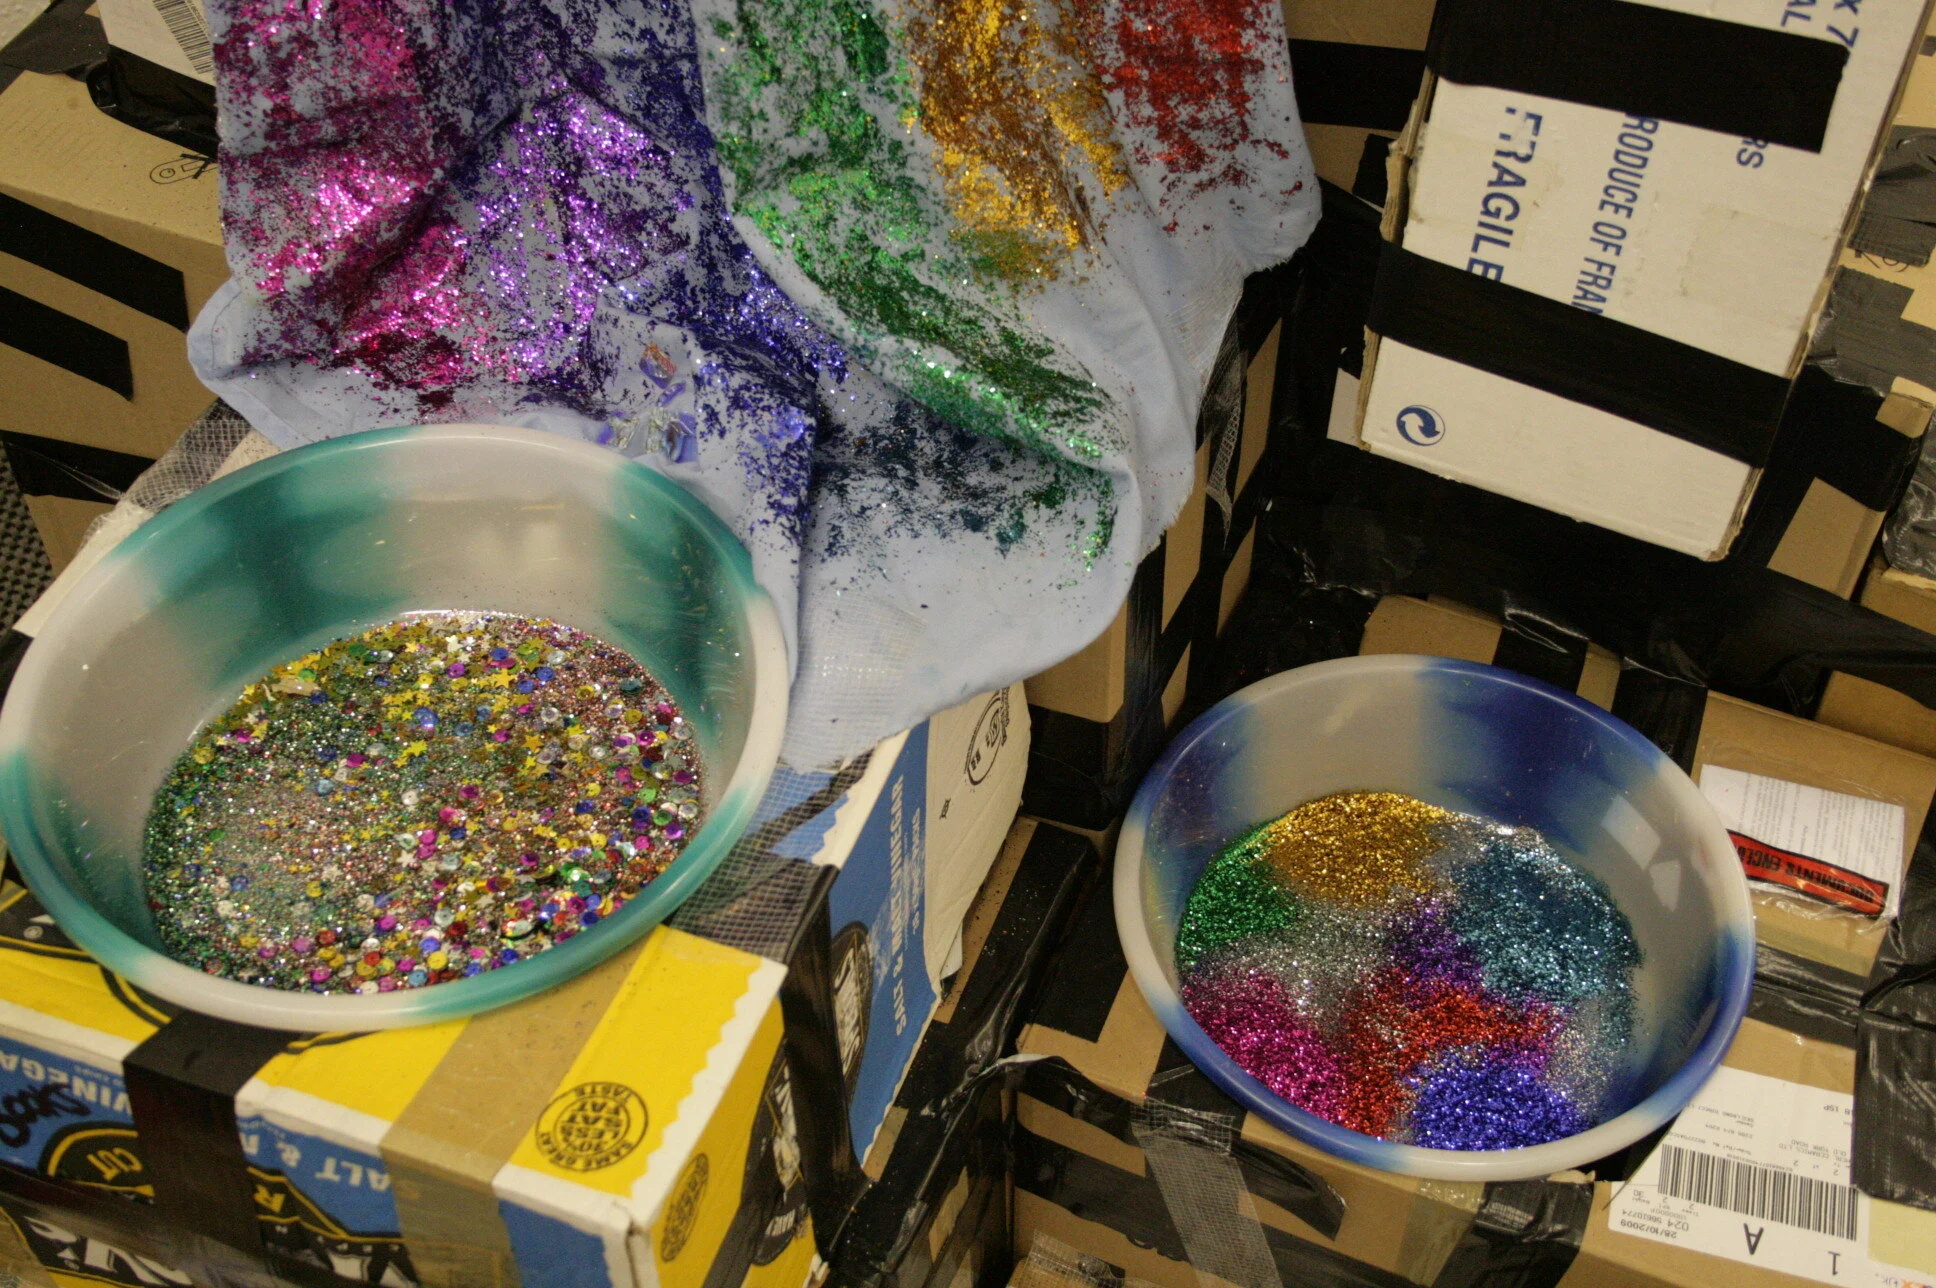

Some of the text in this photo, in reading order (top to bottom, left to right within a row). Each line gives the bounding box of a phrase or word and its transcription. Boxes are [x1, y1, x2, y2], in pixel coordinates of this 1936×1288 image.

[1597, 112, 1660, 220] RODUCE
[1466, 106, 1544, 282] FRAGILE
[1589, 221, 1628, 257] OF
[1735, 845, 1877, 904] DOCUMENTS ENCLO
[0, 1049, 134, 1118] VINEGA
[86, 1146, 143, 1181] CUT
[314, 1155, 393, 1193] ALT
[1620, 1218, 1678, 1240] 28/10/2009
[1743, 1222, 1765, 1256] A
